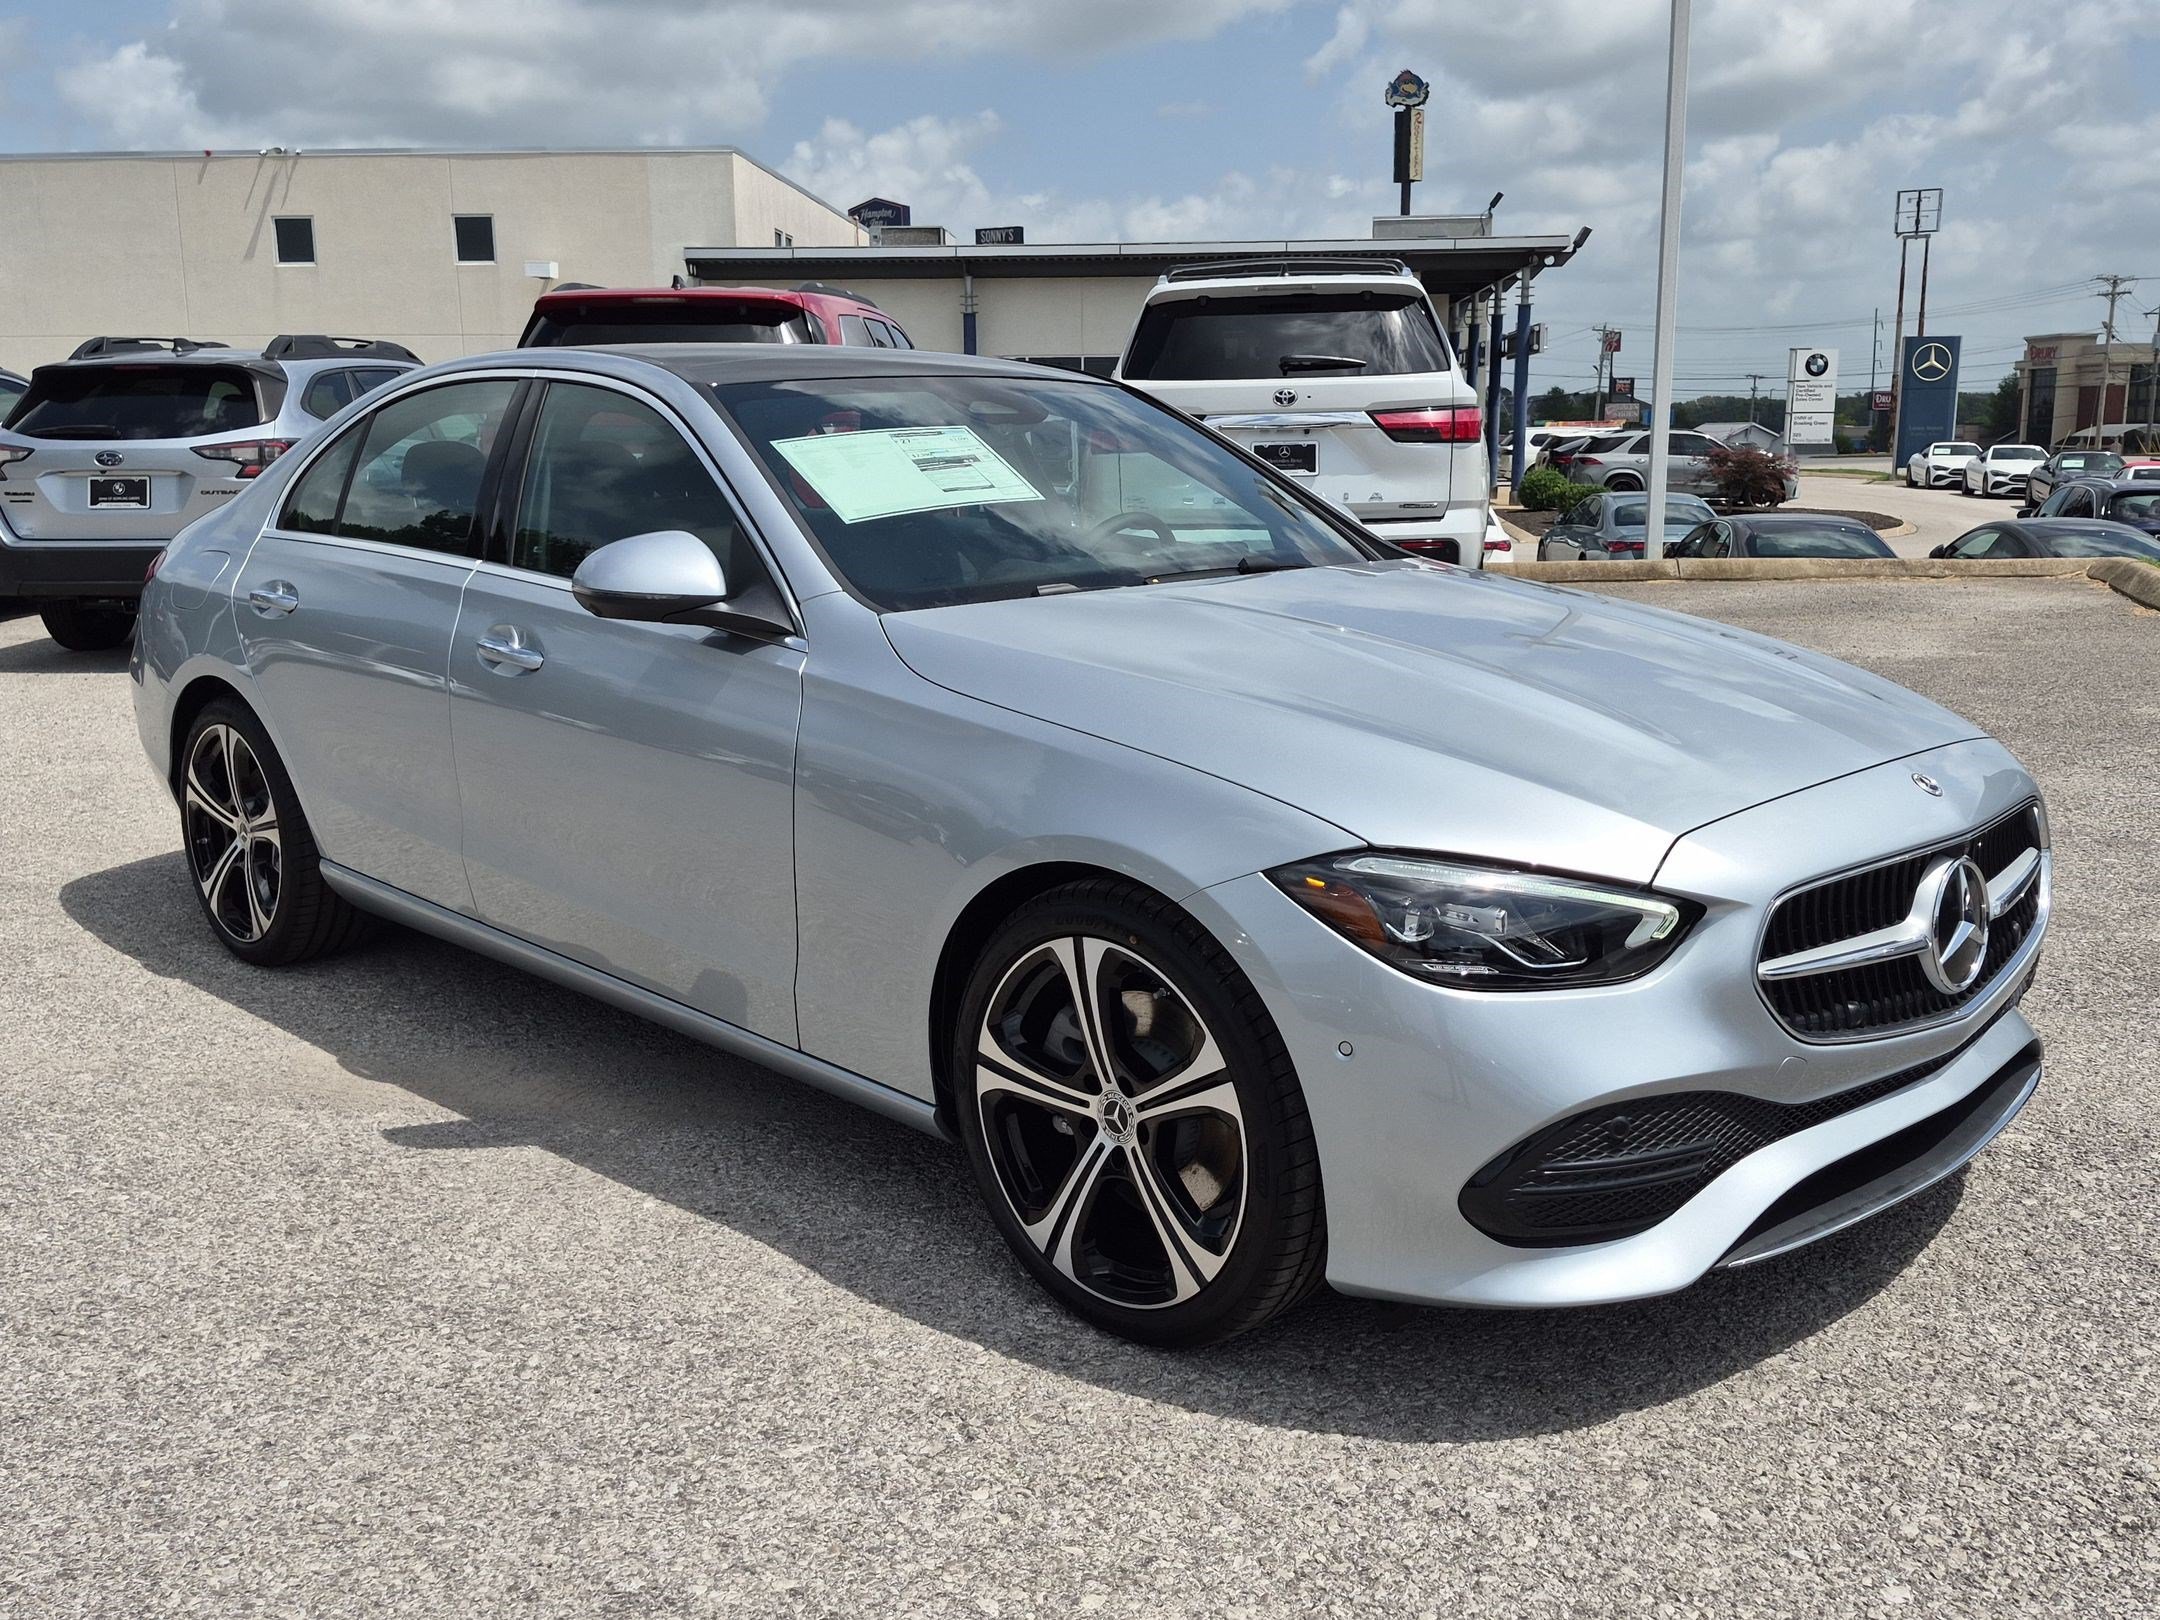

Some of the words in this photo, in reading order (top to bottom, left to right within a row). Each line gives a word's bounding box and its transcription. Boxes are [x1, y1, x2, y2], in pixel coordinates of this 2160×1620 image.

[860, 208, 896, 220] Hampton
[980, 228, 1014, 243] SONNY'S
[2030, 346, 2058, 360] DRURY
